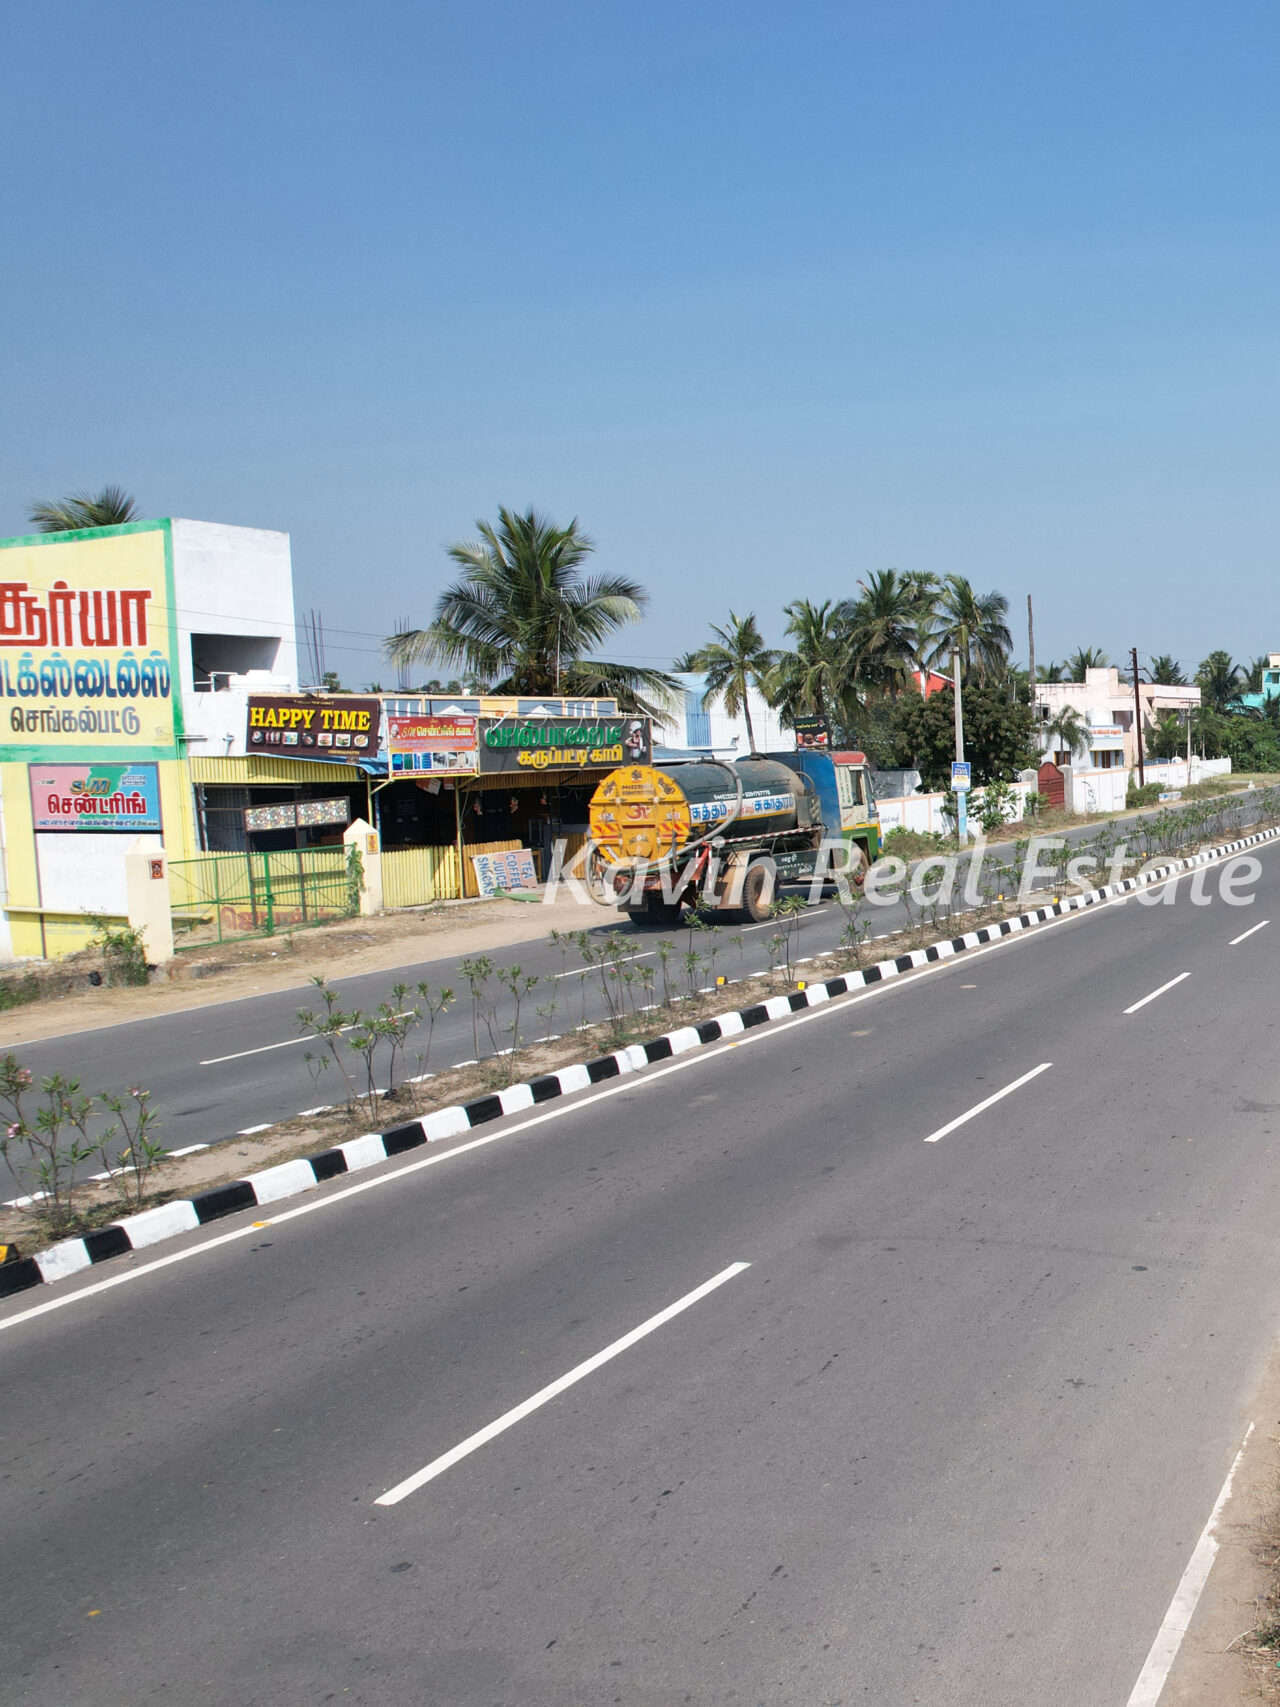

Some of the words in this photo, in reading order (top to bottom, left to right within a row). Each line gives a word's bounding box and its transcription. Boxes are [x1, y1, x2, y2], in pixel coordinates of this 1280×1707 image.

[11, 705, 140, 735] செங்கல்பட்டு
[250, 707, 315, 728] HAPPY
[320, 710, 370, 730] TIME
[518, 747, 588, 768] கருப்பட்டி
[591, 744, 623, 762] காபி
[691, 801, 727, 820] சுத்தம்
[478, 857, 496, 894] SNACKS
[493, 861, 507, 886] JUICE
[506, 854, 522, 888] COFFEE
[521, 861, 533, 879] TEA
